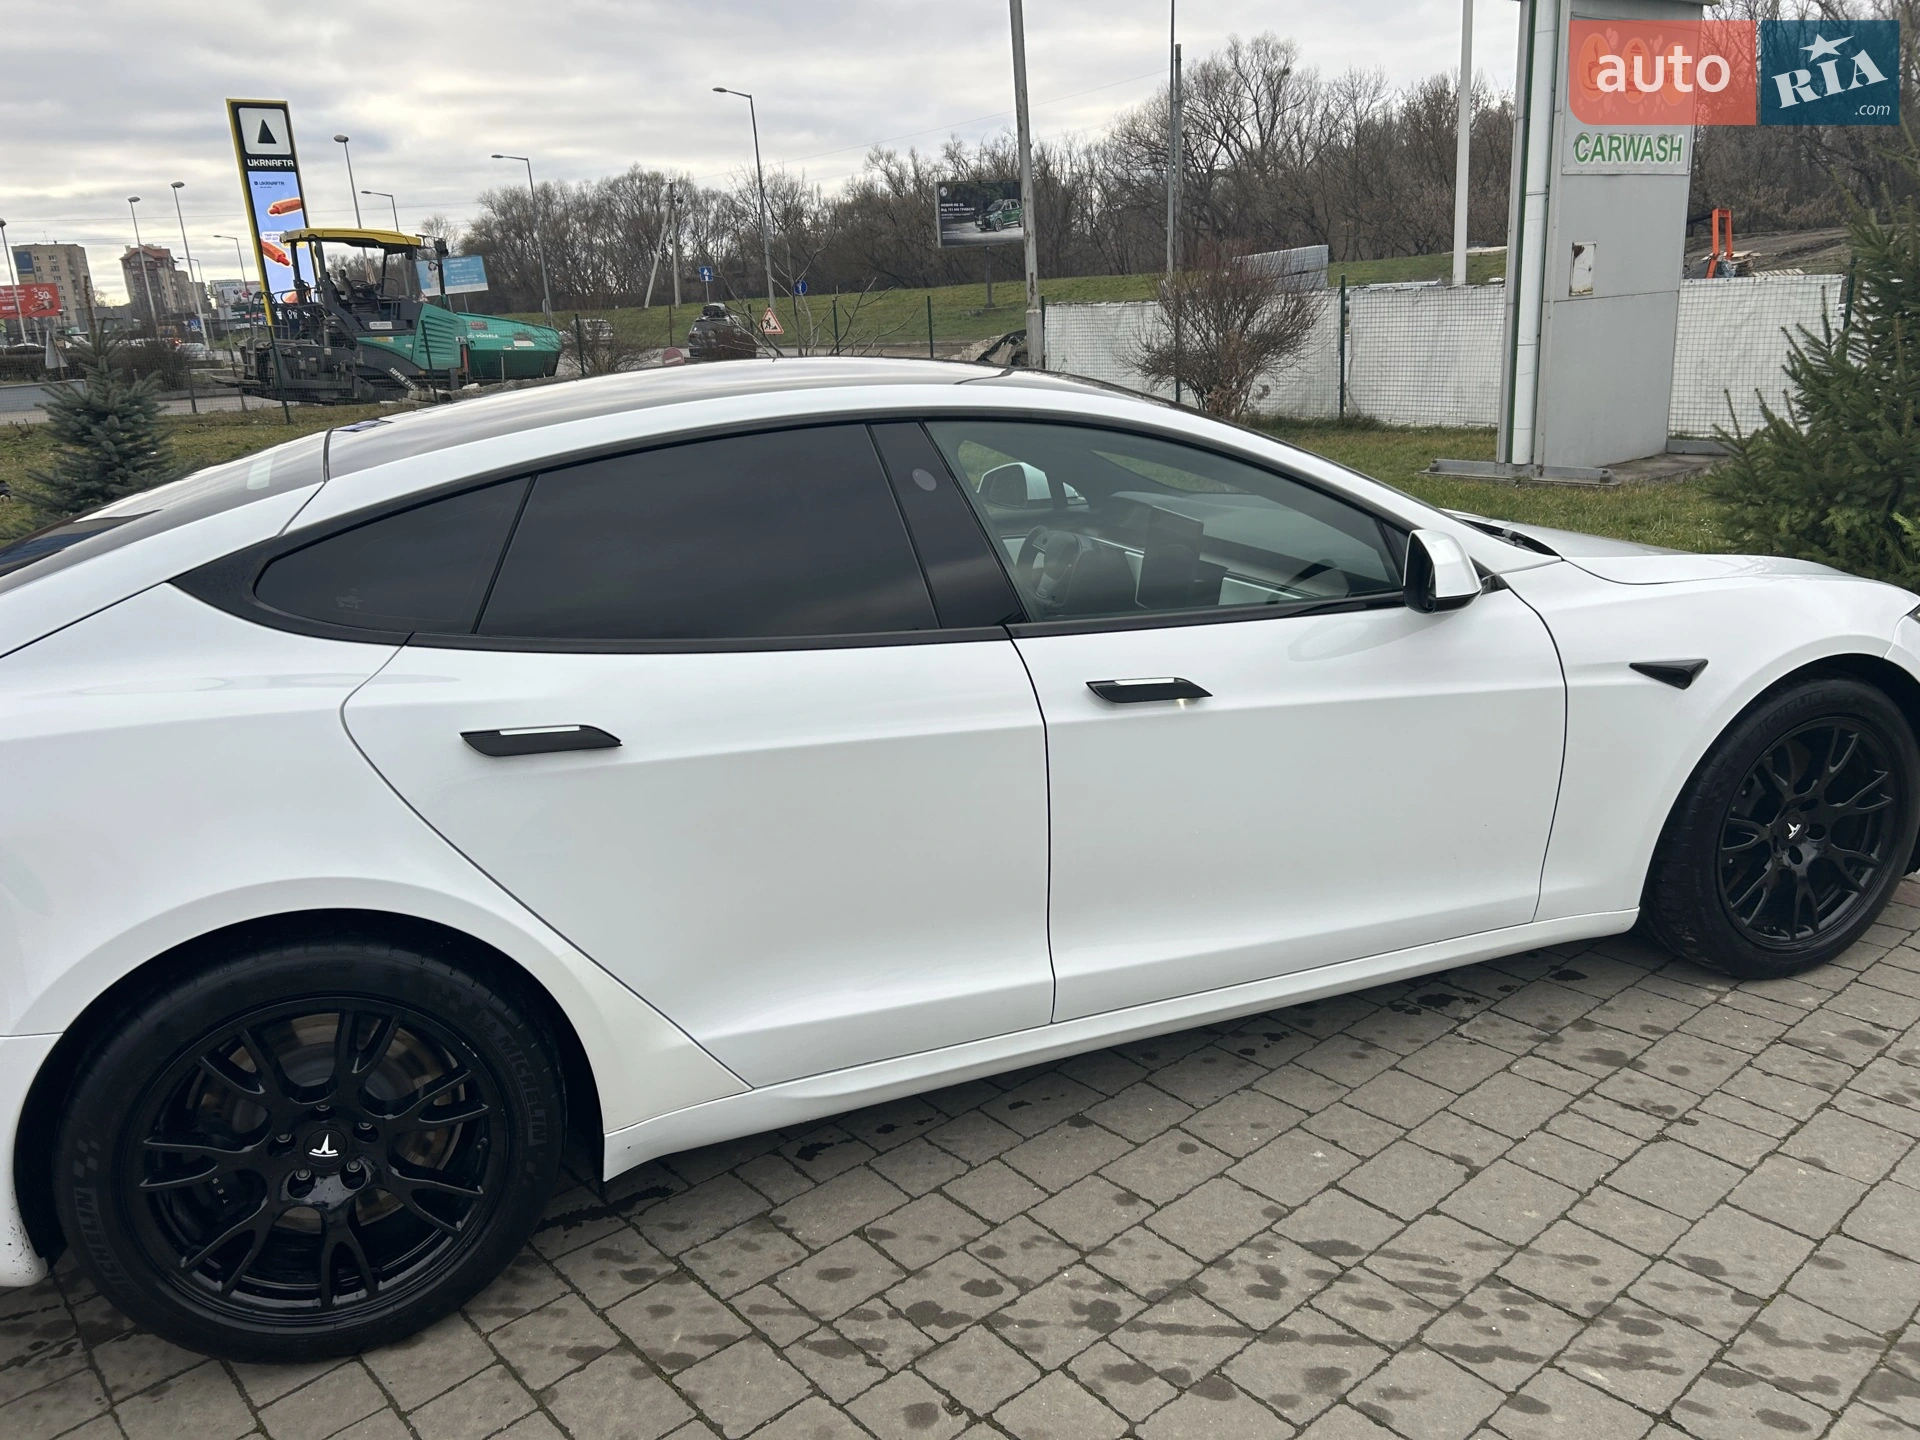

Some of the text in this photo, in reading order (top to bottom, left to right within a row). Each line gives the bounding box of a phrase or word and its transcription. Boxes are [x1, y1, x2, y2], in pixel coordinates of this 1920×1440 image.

[247, 158, 295, 167] UKRNAFTA
[1573, 133, 1684, 164] CARWASH
[389, 367, 407, 382] SUPER
[497, 1034, 547, 1143] MICHELIN
[74, 1187, 136, 1295] MICHELIN
